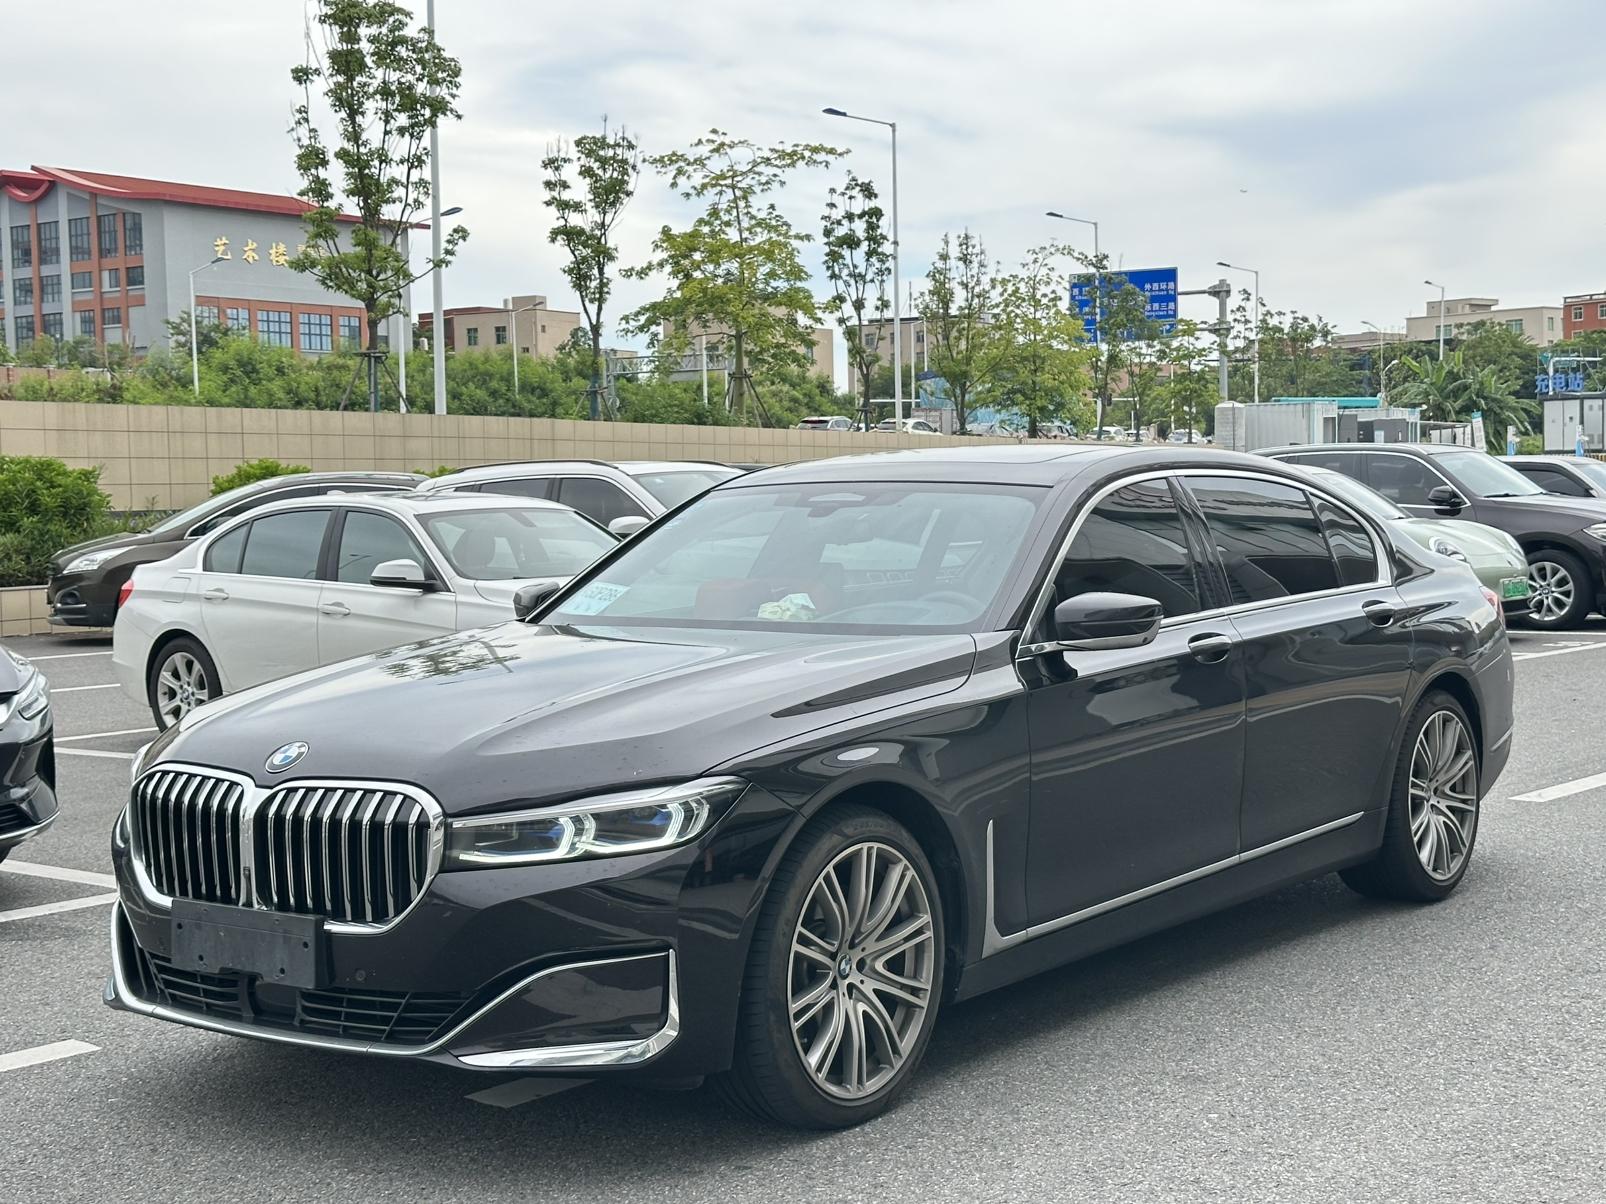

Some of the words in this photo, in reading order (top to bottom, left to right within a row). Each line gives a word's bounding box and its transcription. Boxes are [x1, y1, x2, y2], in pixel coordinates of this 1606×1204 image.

[213, 236, 289, 266] 艺术楼
[1144, 281, 1175, 291] 外西环路
[1535, 372, 1584, 393] 充电站
